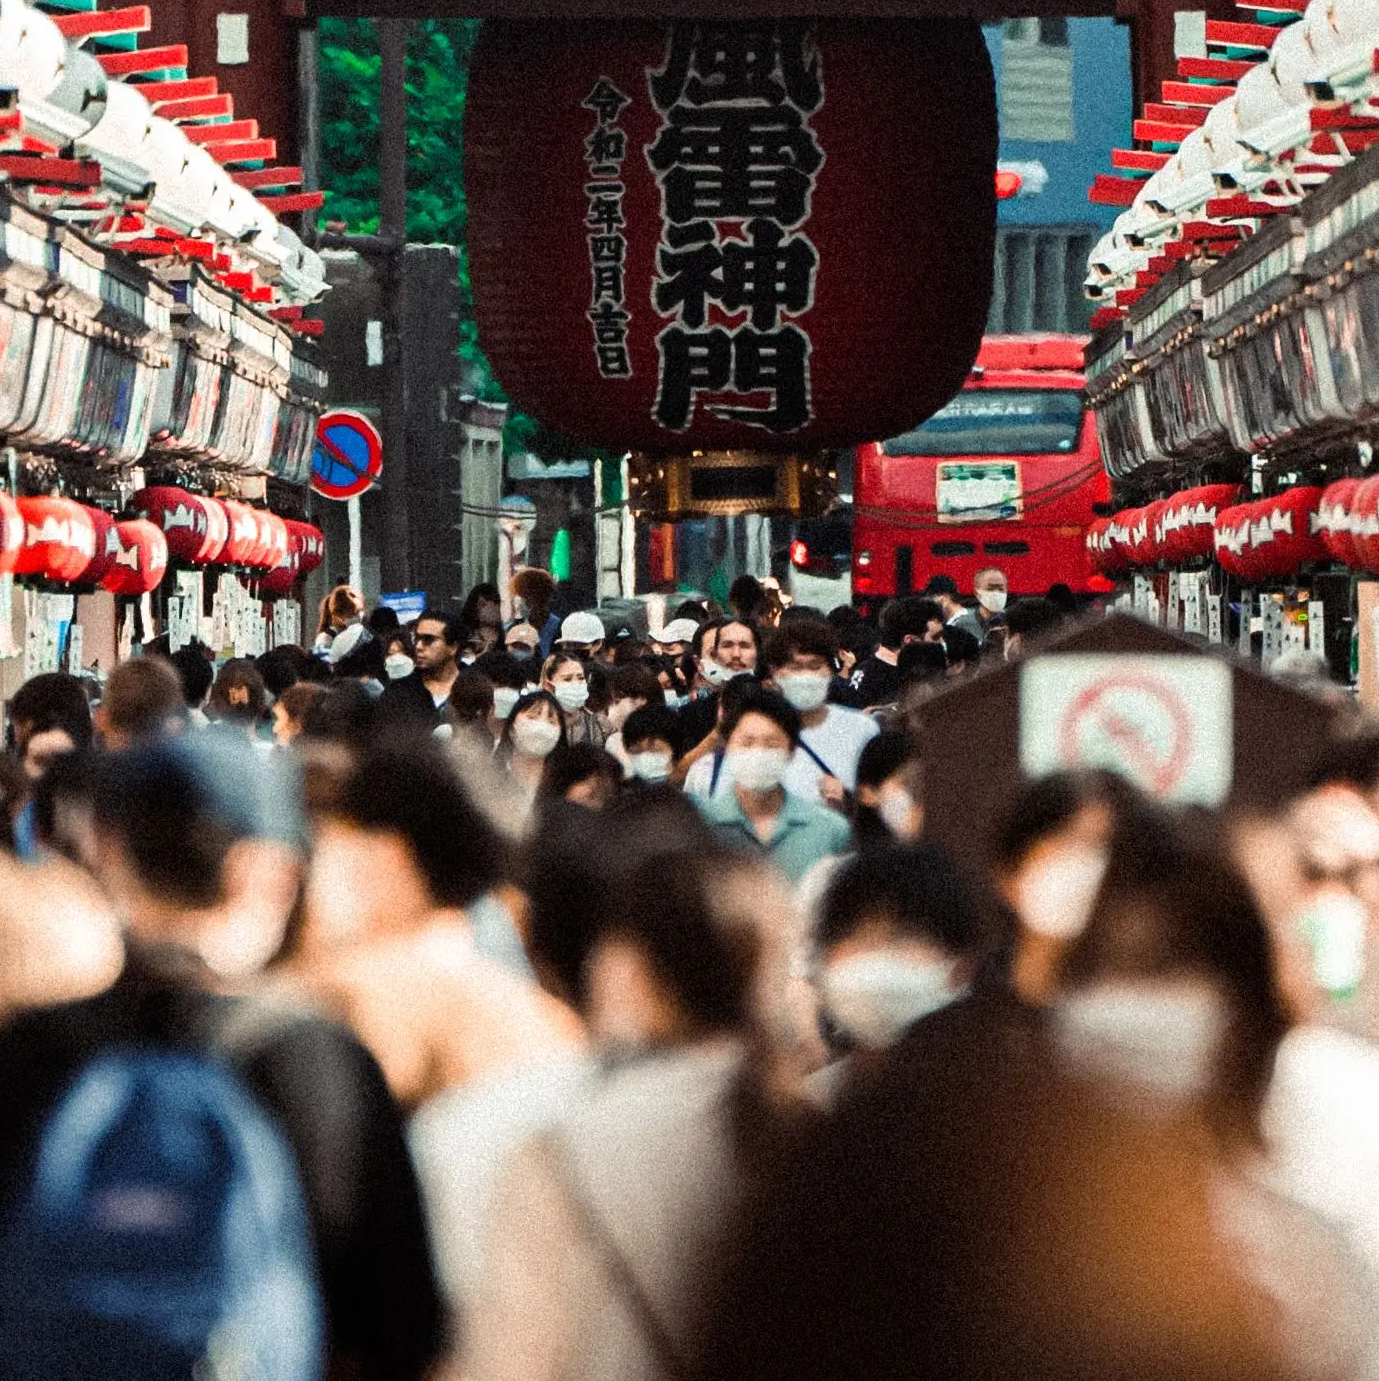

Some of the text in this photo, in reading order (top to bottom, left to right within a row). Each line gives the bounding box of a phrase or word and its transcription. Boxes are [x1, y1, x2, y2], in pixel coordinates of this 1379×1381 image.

[582, 76, 632, 379] 令和二年四月吉日
